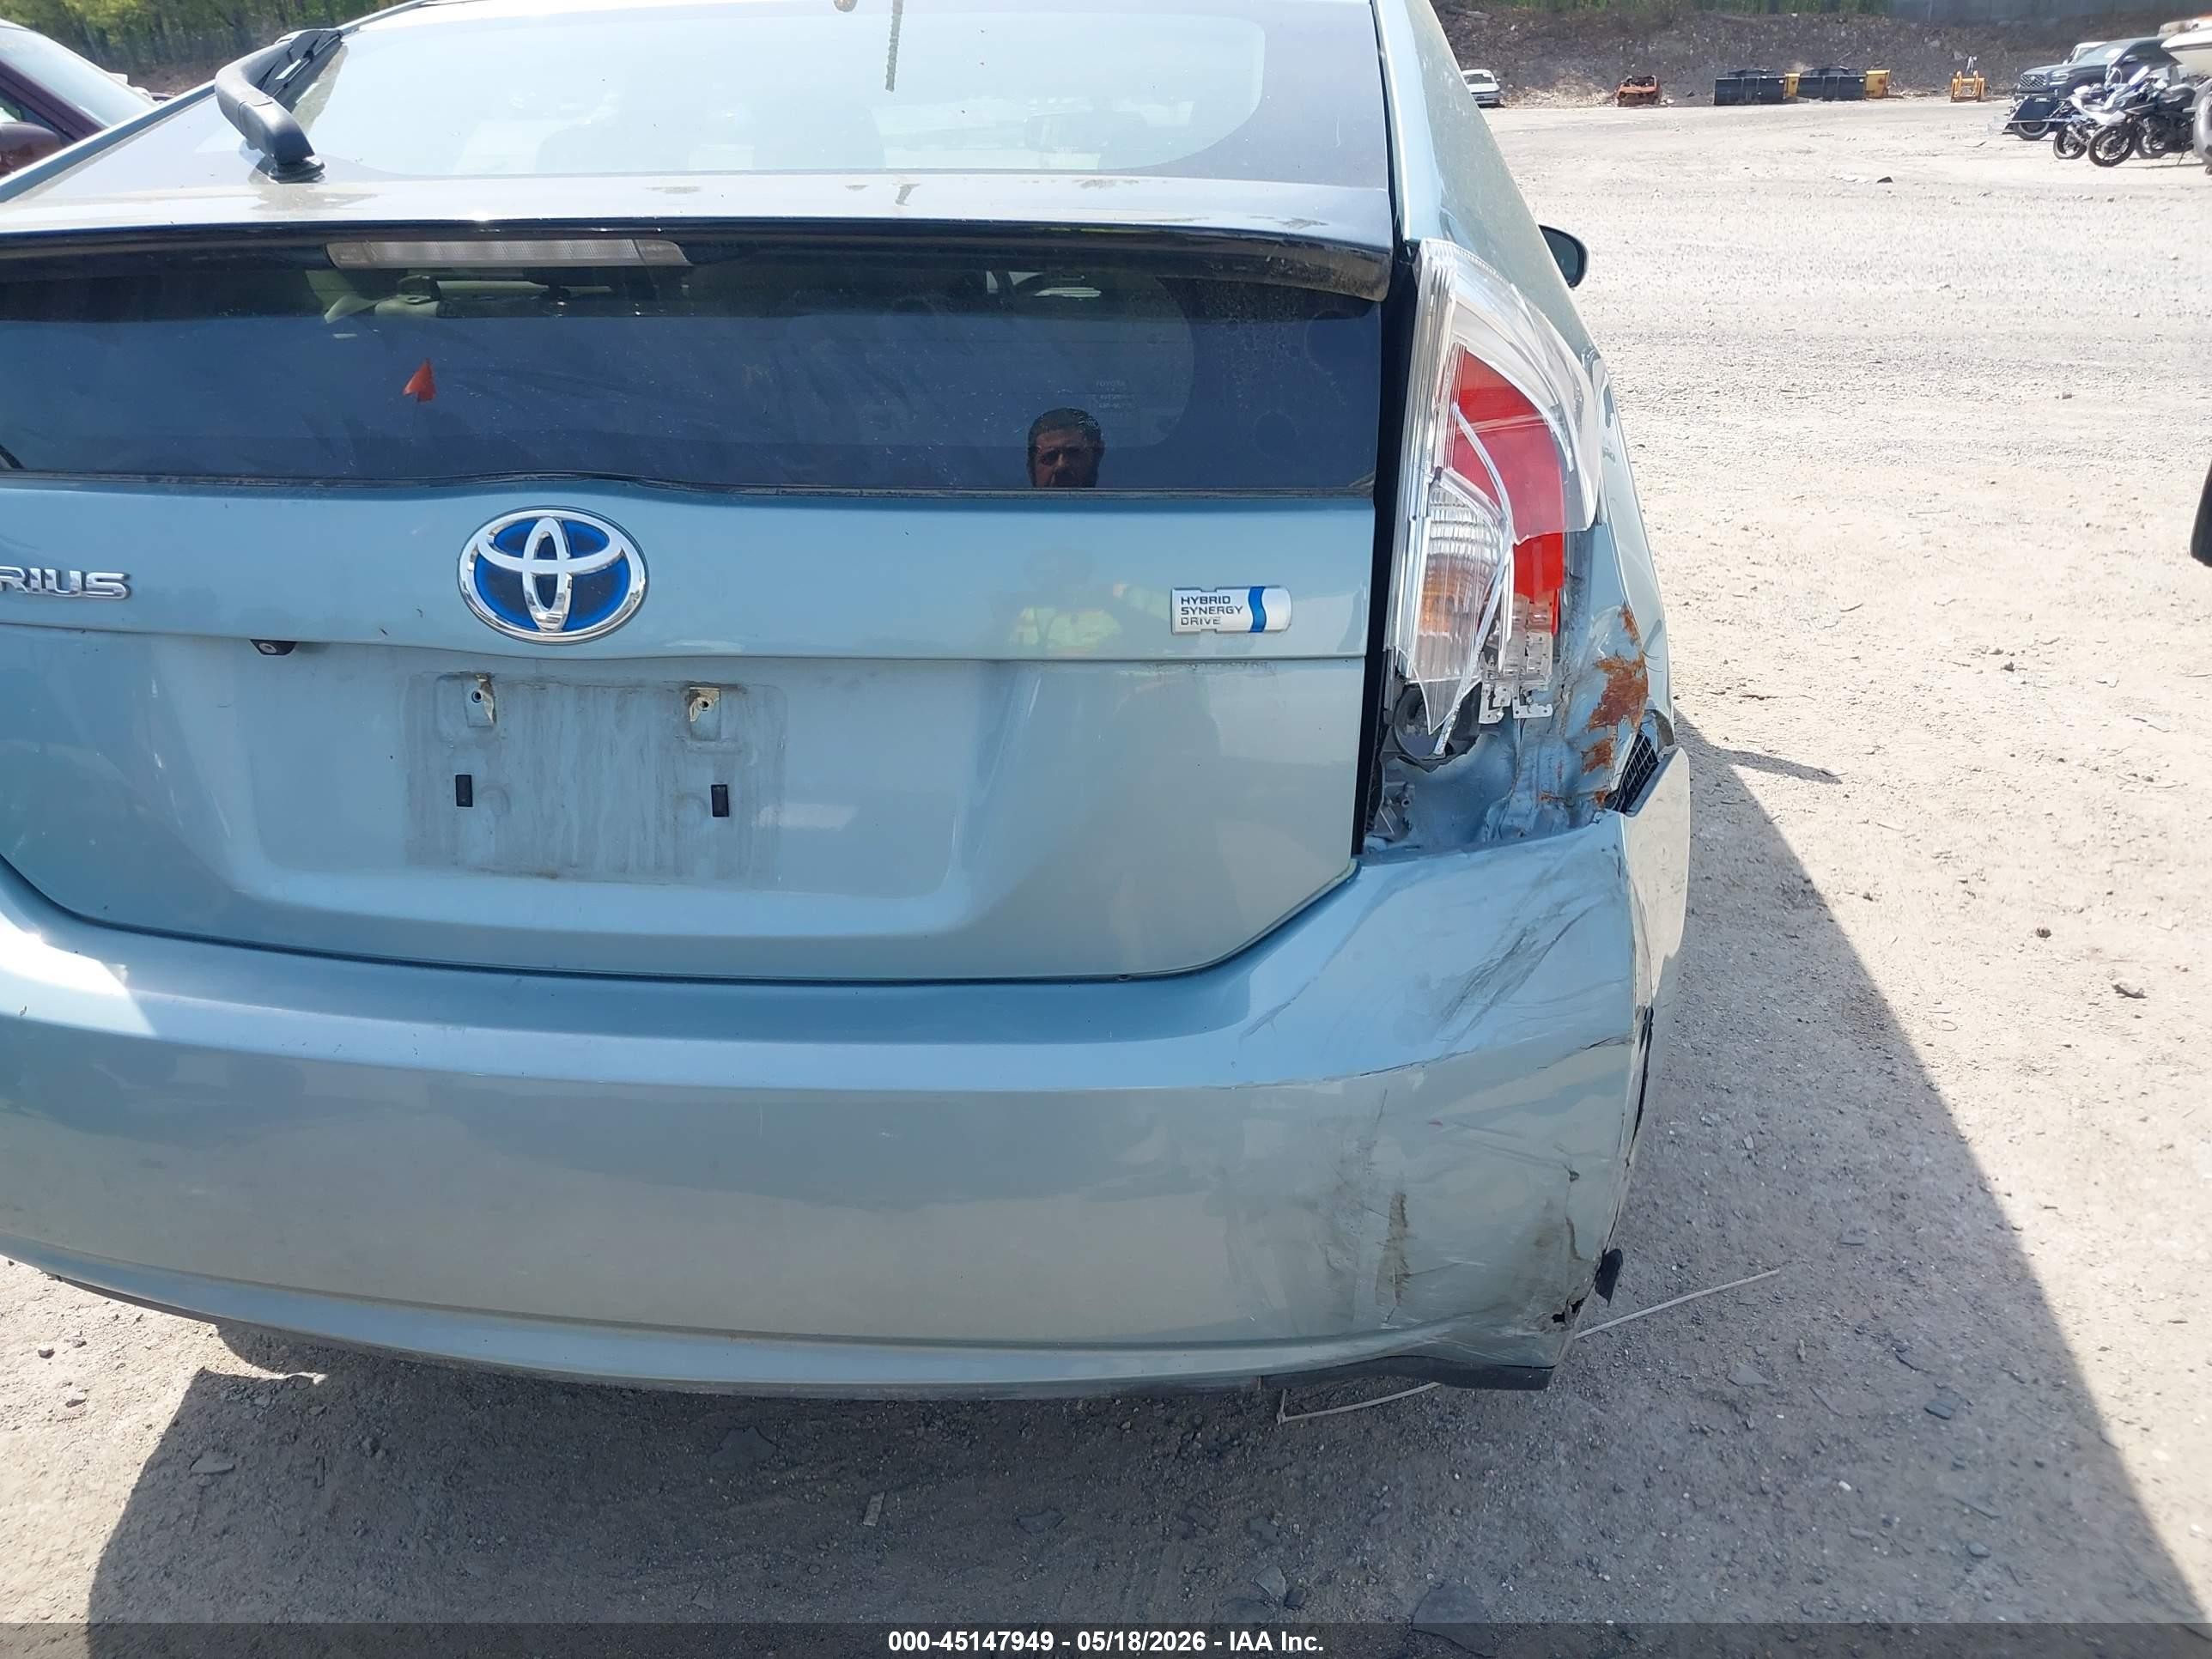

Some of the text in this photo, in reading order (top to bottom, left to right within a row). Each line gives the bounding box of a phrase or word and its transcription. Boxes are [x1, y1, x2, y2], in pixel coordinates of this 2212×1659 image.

[1181, 595, 1231, 605] HYBRID
[1181, 605, 1243, 616] SYNERGY
[1181, 617, 1221, 626] DRIVE
